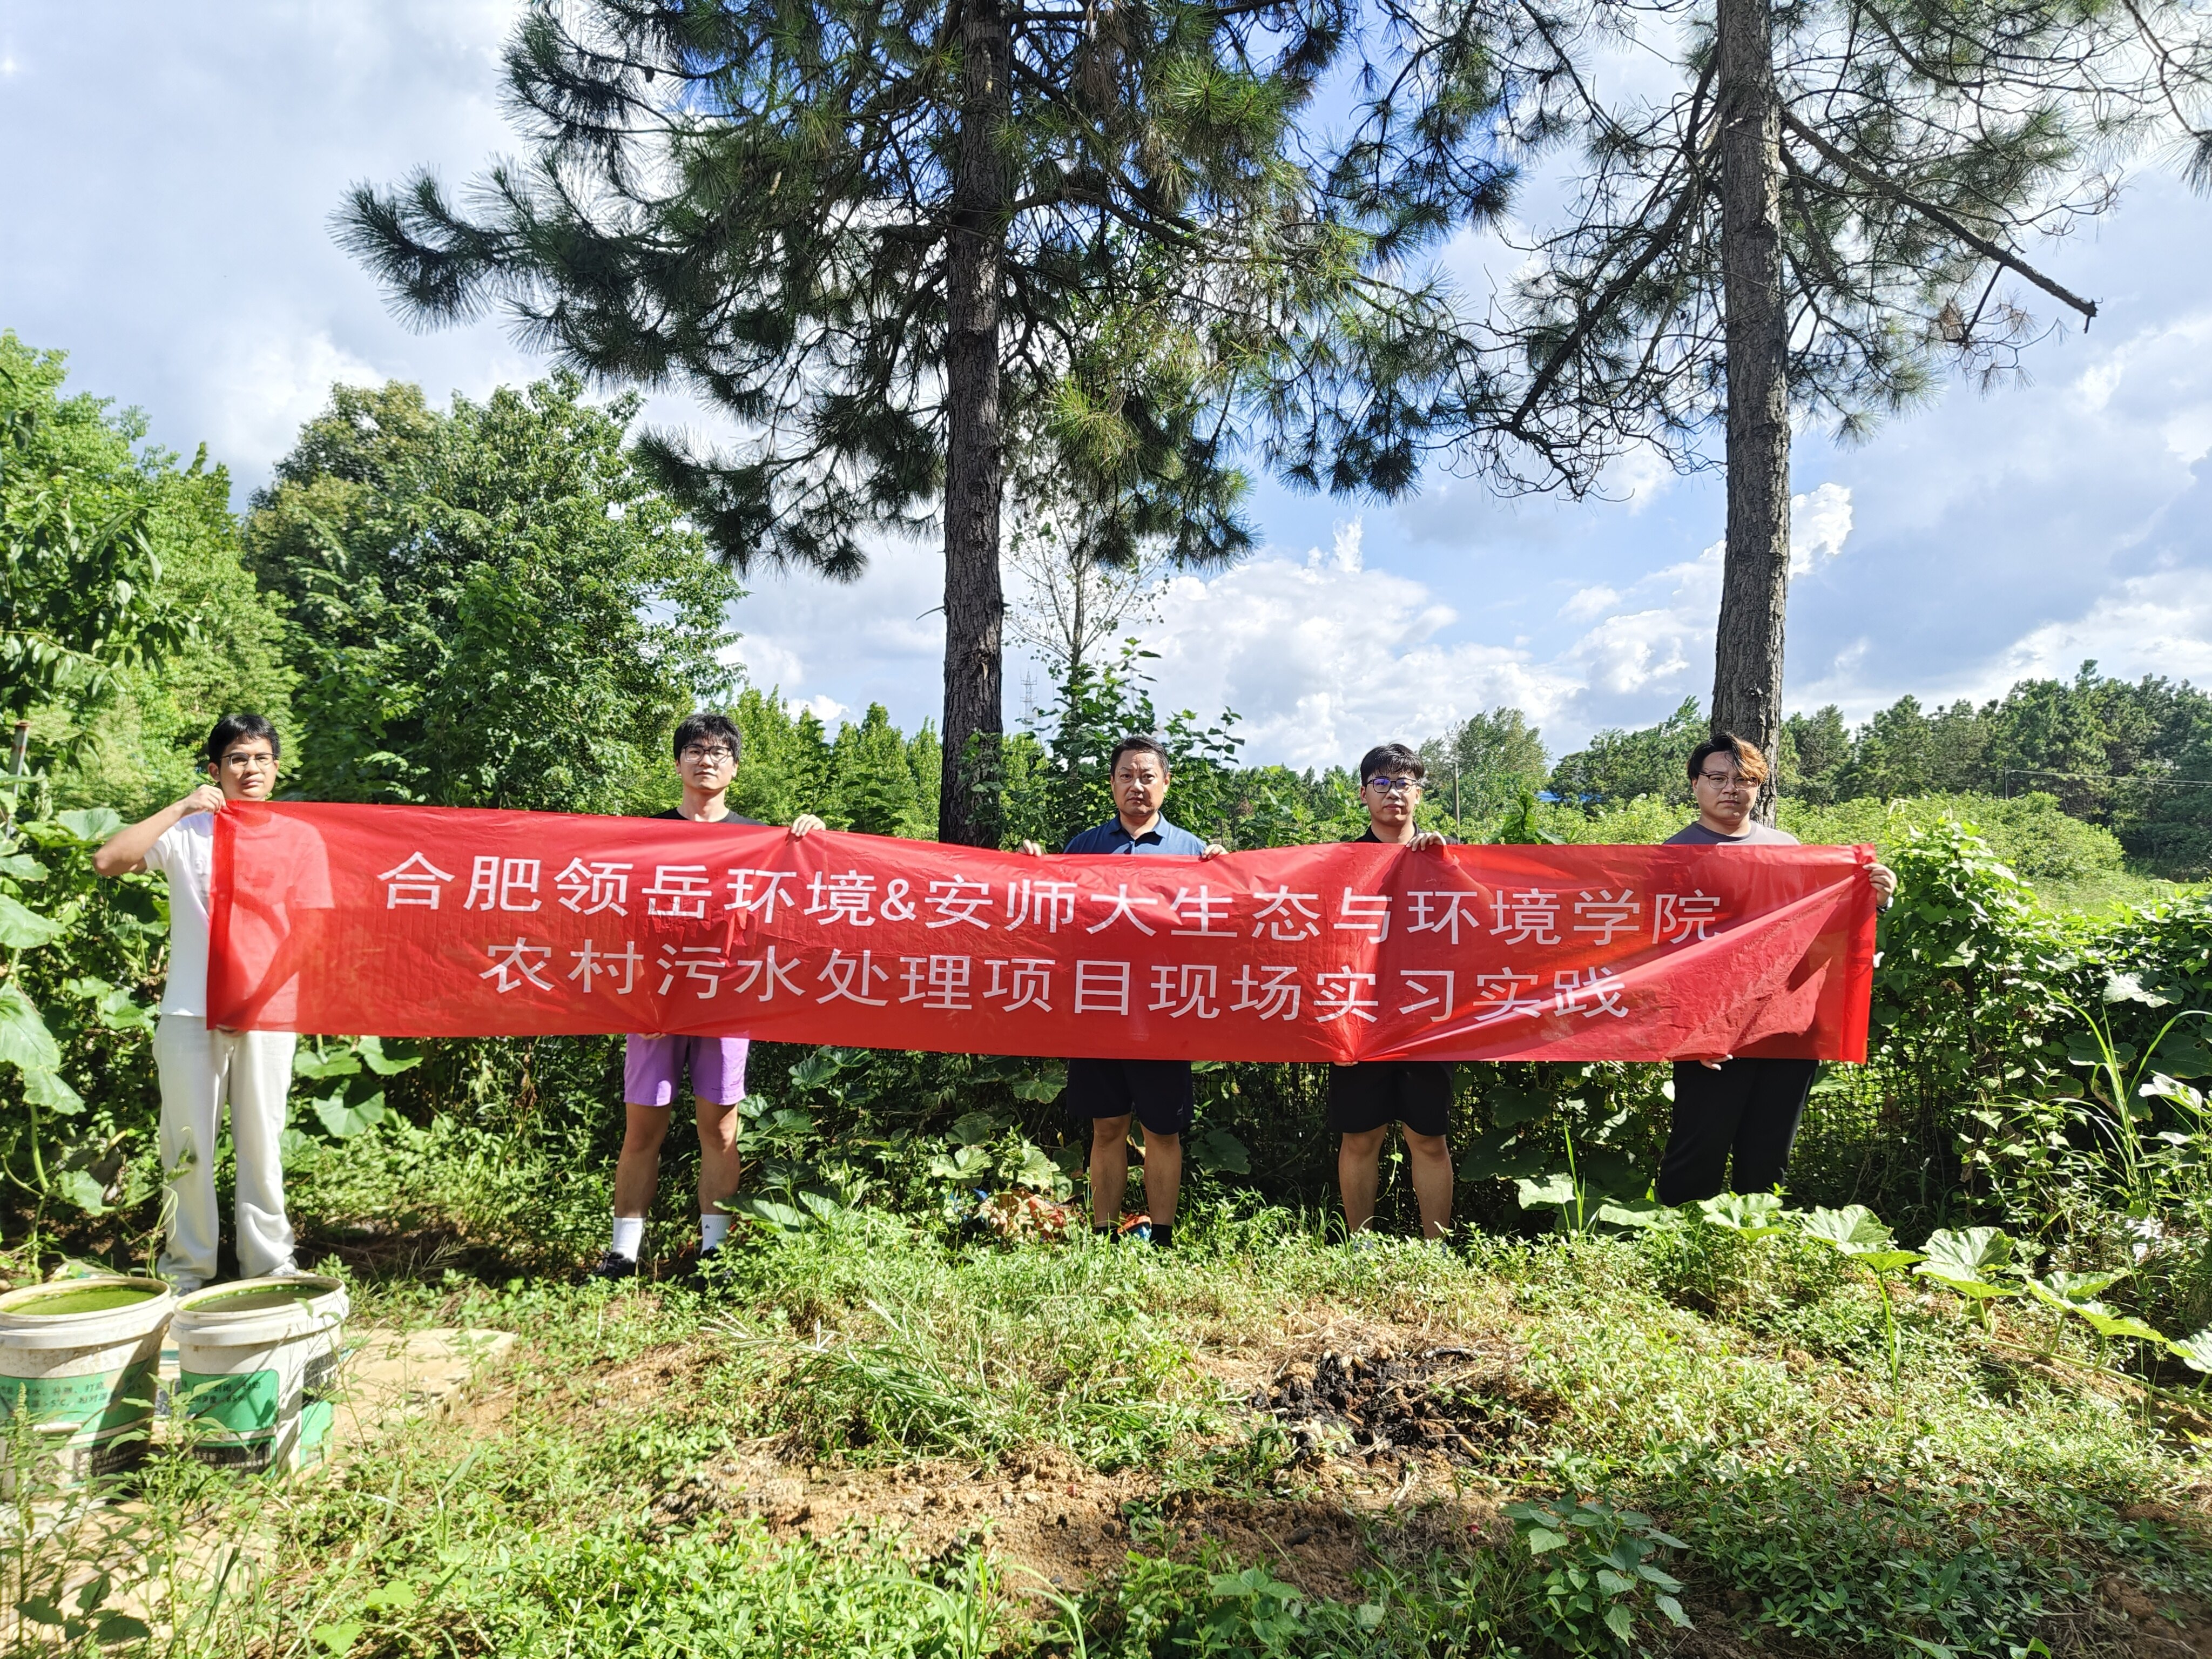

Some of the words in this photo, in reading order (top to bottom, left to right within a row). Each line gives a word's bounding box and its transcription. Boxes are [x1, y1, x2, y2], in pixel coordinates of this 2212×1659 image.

[377, 851, 1723, 946] 合肥领岳环境&安师大生态与环境学院
[478, 936, 1629, 1023] 农村污水处理项目现场实习实践
